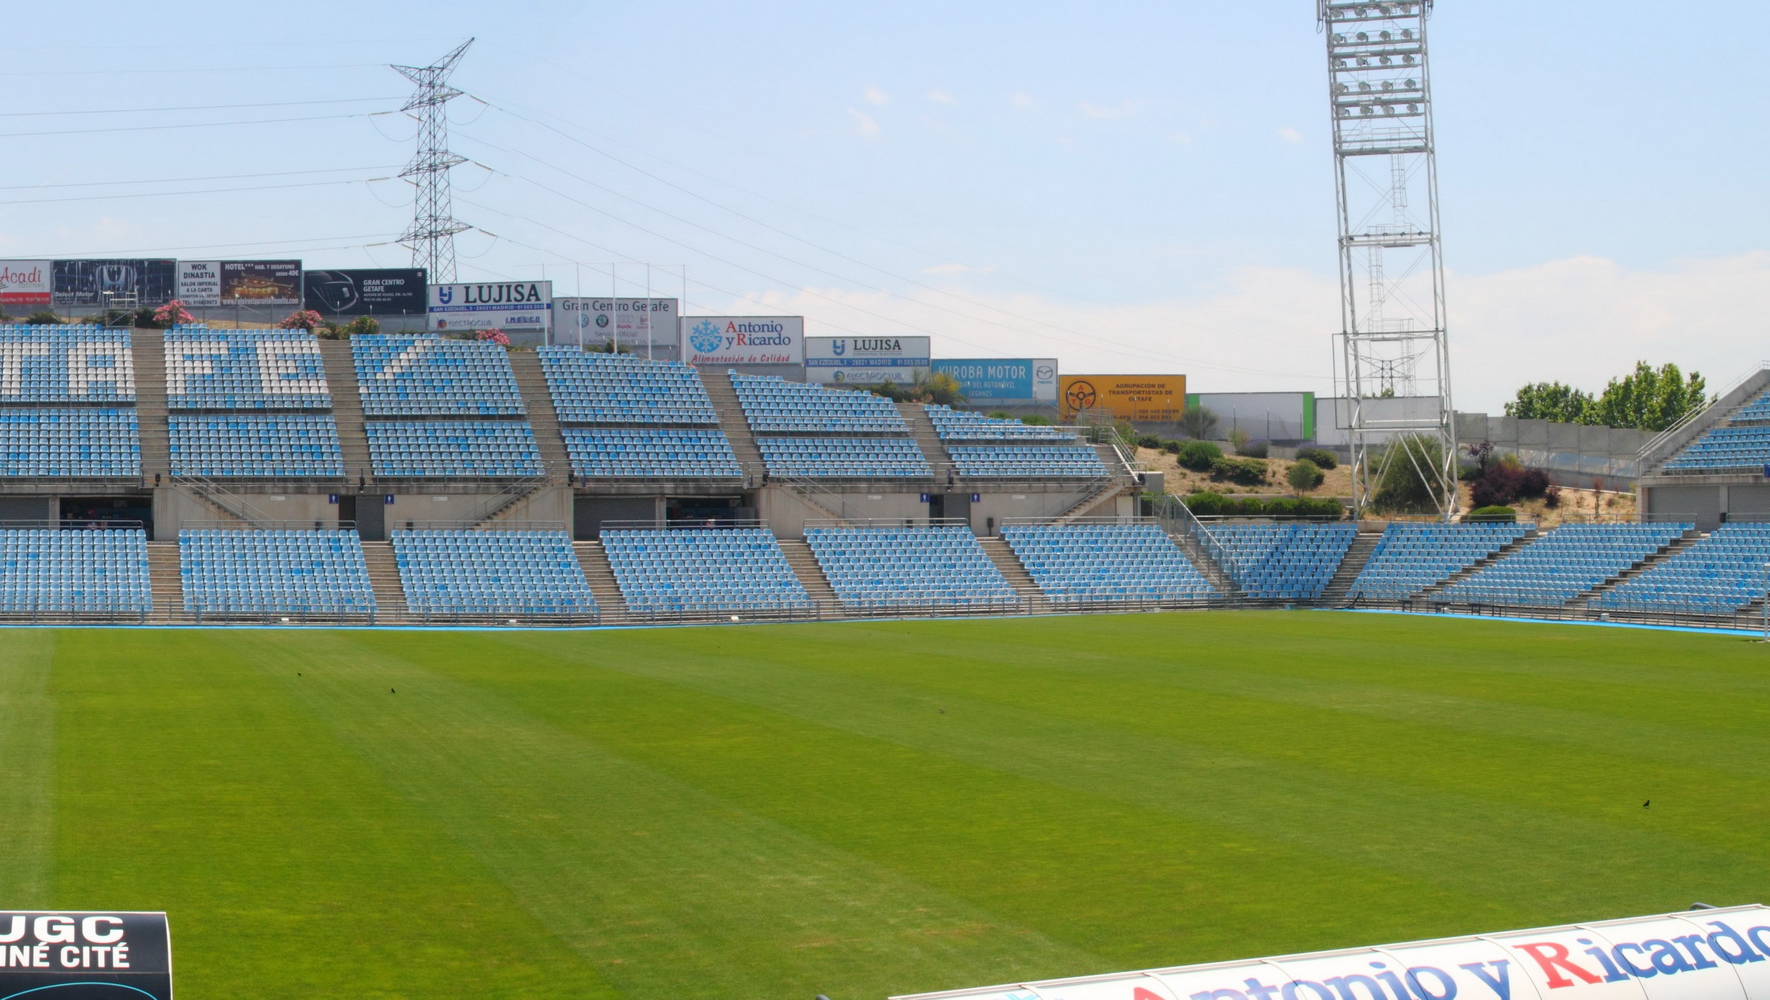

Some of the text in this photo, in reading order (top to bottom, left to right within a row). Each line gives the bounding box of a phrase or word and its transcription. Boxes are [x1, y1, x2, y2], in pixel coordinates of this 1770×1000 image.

[464, 284, 542, 304] LUJISA
[562, 300, 589, 312] Gran
[725, 320, 784, 334] Antonio
[726, 333, 791, 349] y Ricardo
[853, 339, 902, 351] LUJISA
[692, 353, 790, 364] Alimentación de Calidad
[938, 366, 1026, 379] KUROBA MOTOR
[60, 942, 130, 968] CITÉ
